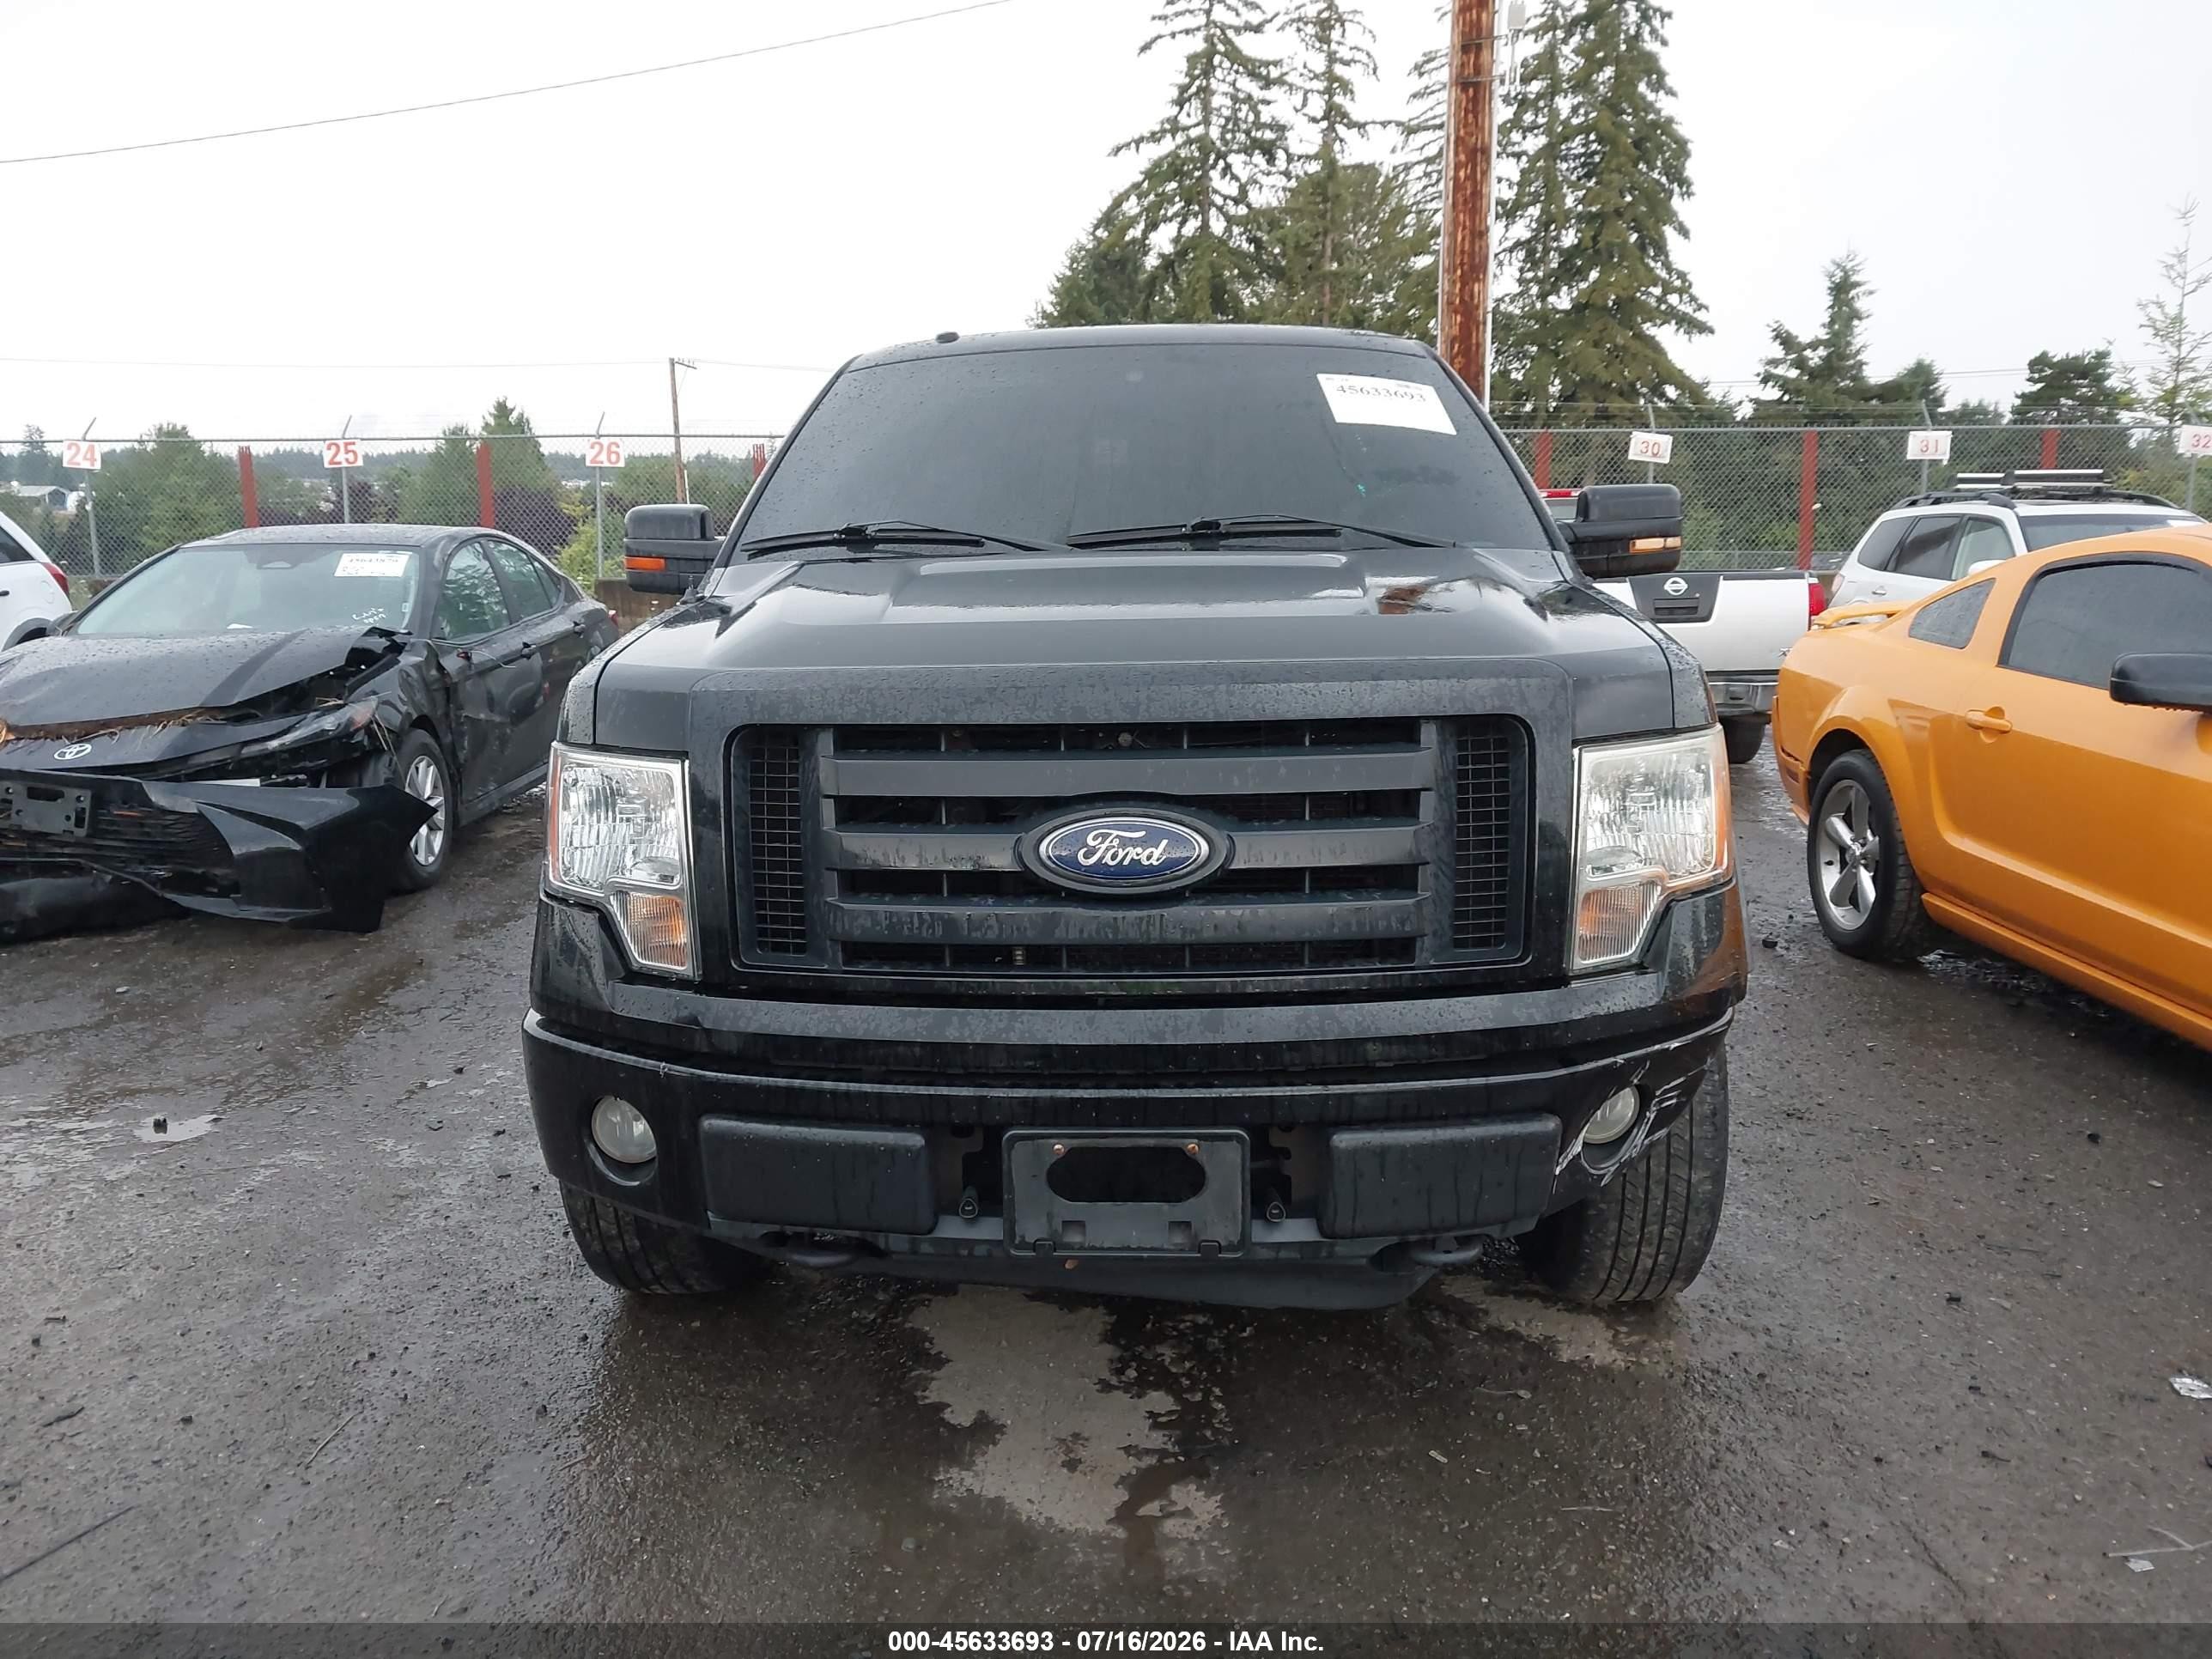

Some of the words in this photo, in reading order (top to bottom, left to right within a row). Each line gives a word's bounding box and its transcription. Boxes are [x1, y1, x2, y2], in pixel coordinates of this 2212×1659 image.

[1335, 384, 1427, 403] 45633693
[1640, 440, 1661, 458] 30
[1919, 439, 1939, 453] 31
[2191, 433, 2212, 448] 32
[66, 441, 97, 468] 24
[326, 441, 358, 466] 25
[590, 441, 621, 465] 26
[1077, 829, 1169, 866] Ford
